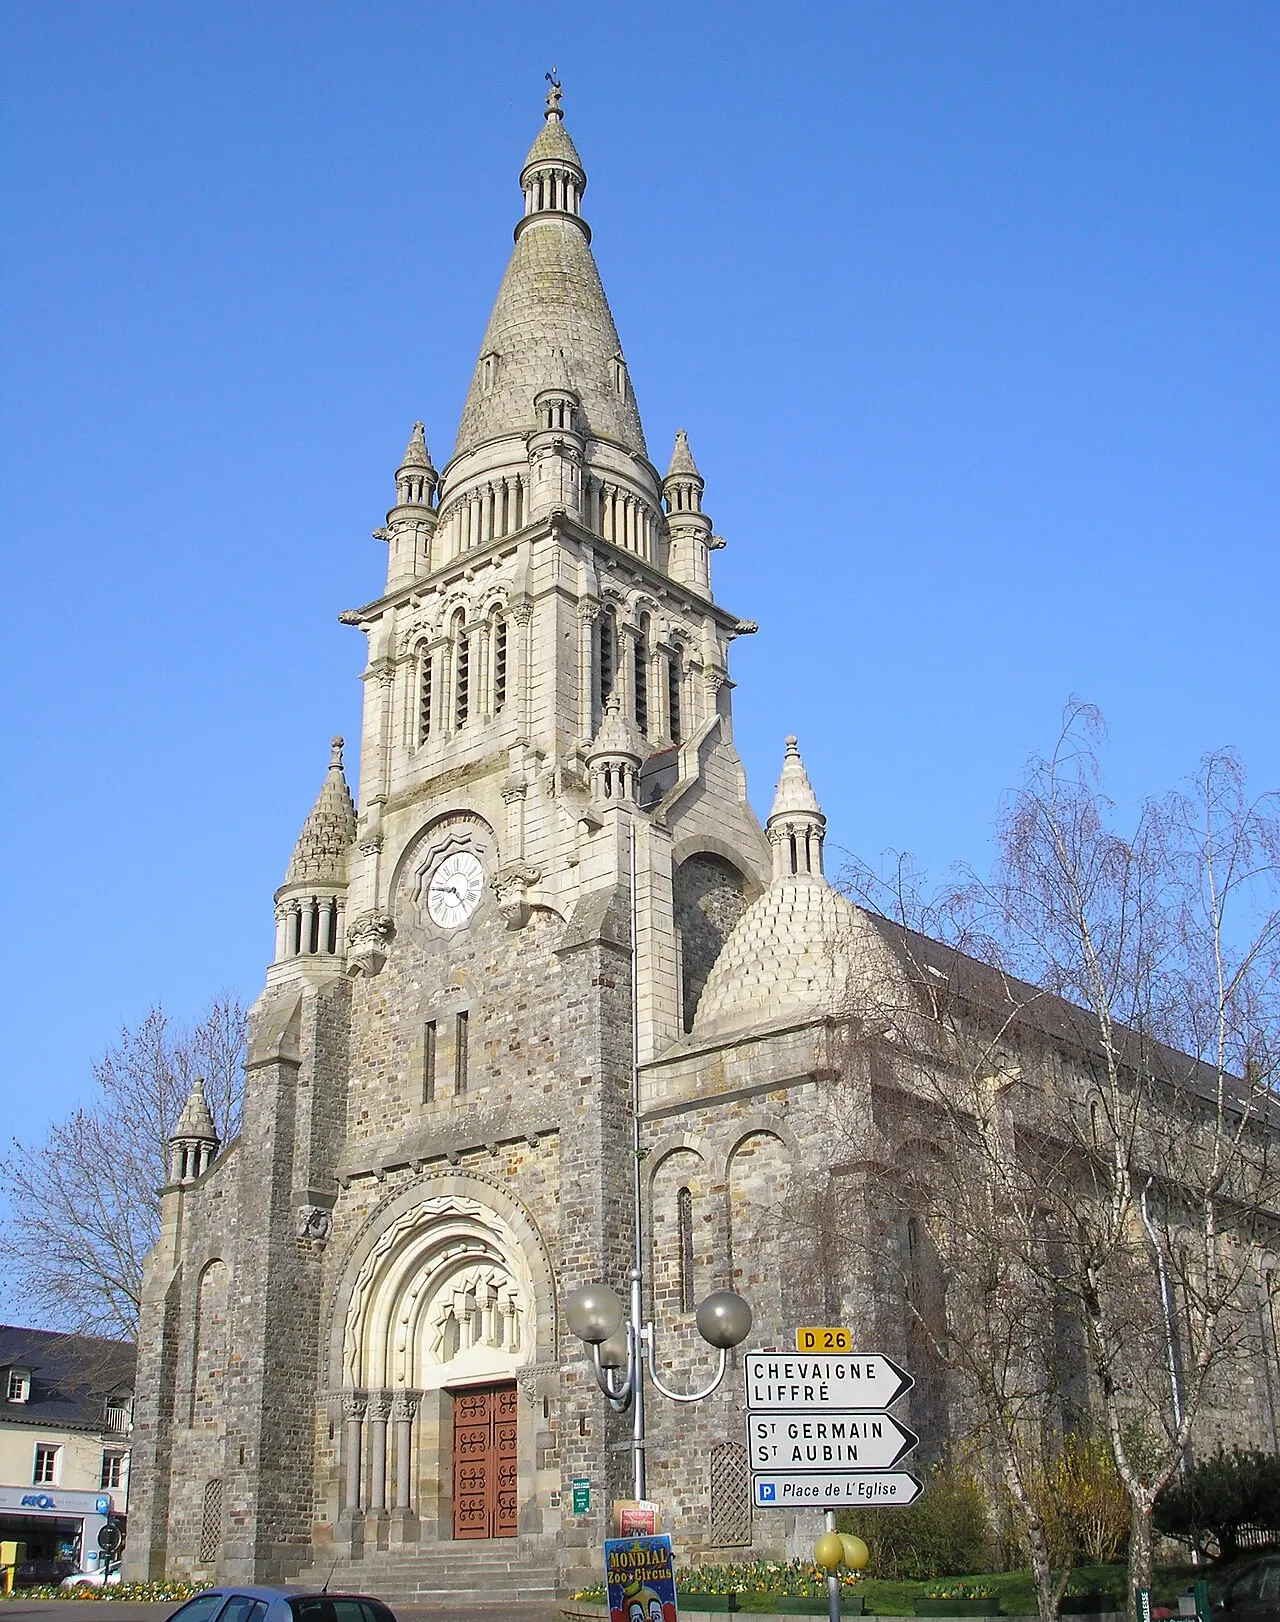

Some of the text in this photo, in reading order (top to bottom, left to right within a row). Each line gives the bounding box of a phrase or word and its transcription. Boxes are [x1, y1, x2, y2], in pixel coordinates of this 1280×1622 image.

[805, 1333, 846, 1348] D 26
[754, 1363, 876, 1379] CHEVAIGNE
[755, 1381, 830, 1401] LIFFRÉ
[788, 1423, 883, 1439] GERMAIN
[792, 1445, 858, 1461] AUBIN
[763, 1486, 772, 1499] P
[783, 1483, 819, 1497] Place
[825, 1483, 841, 1496] de
[610, 1547, 668, 1568] MONDIAL
[608, 1568, 672, 1584] Zoo Circus
